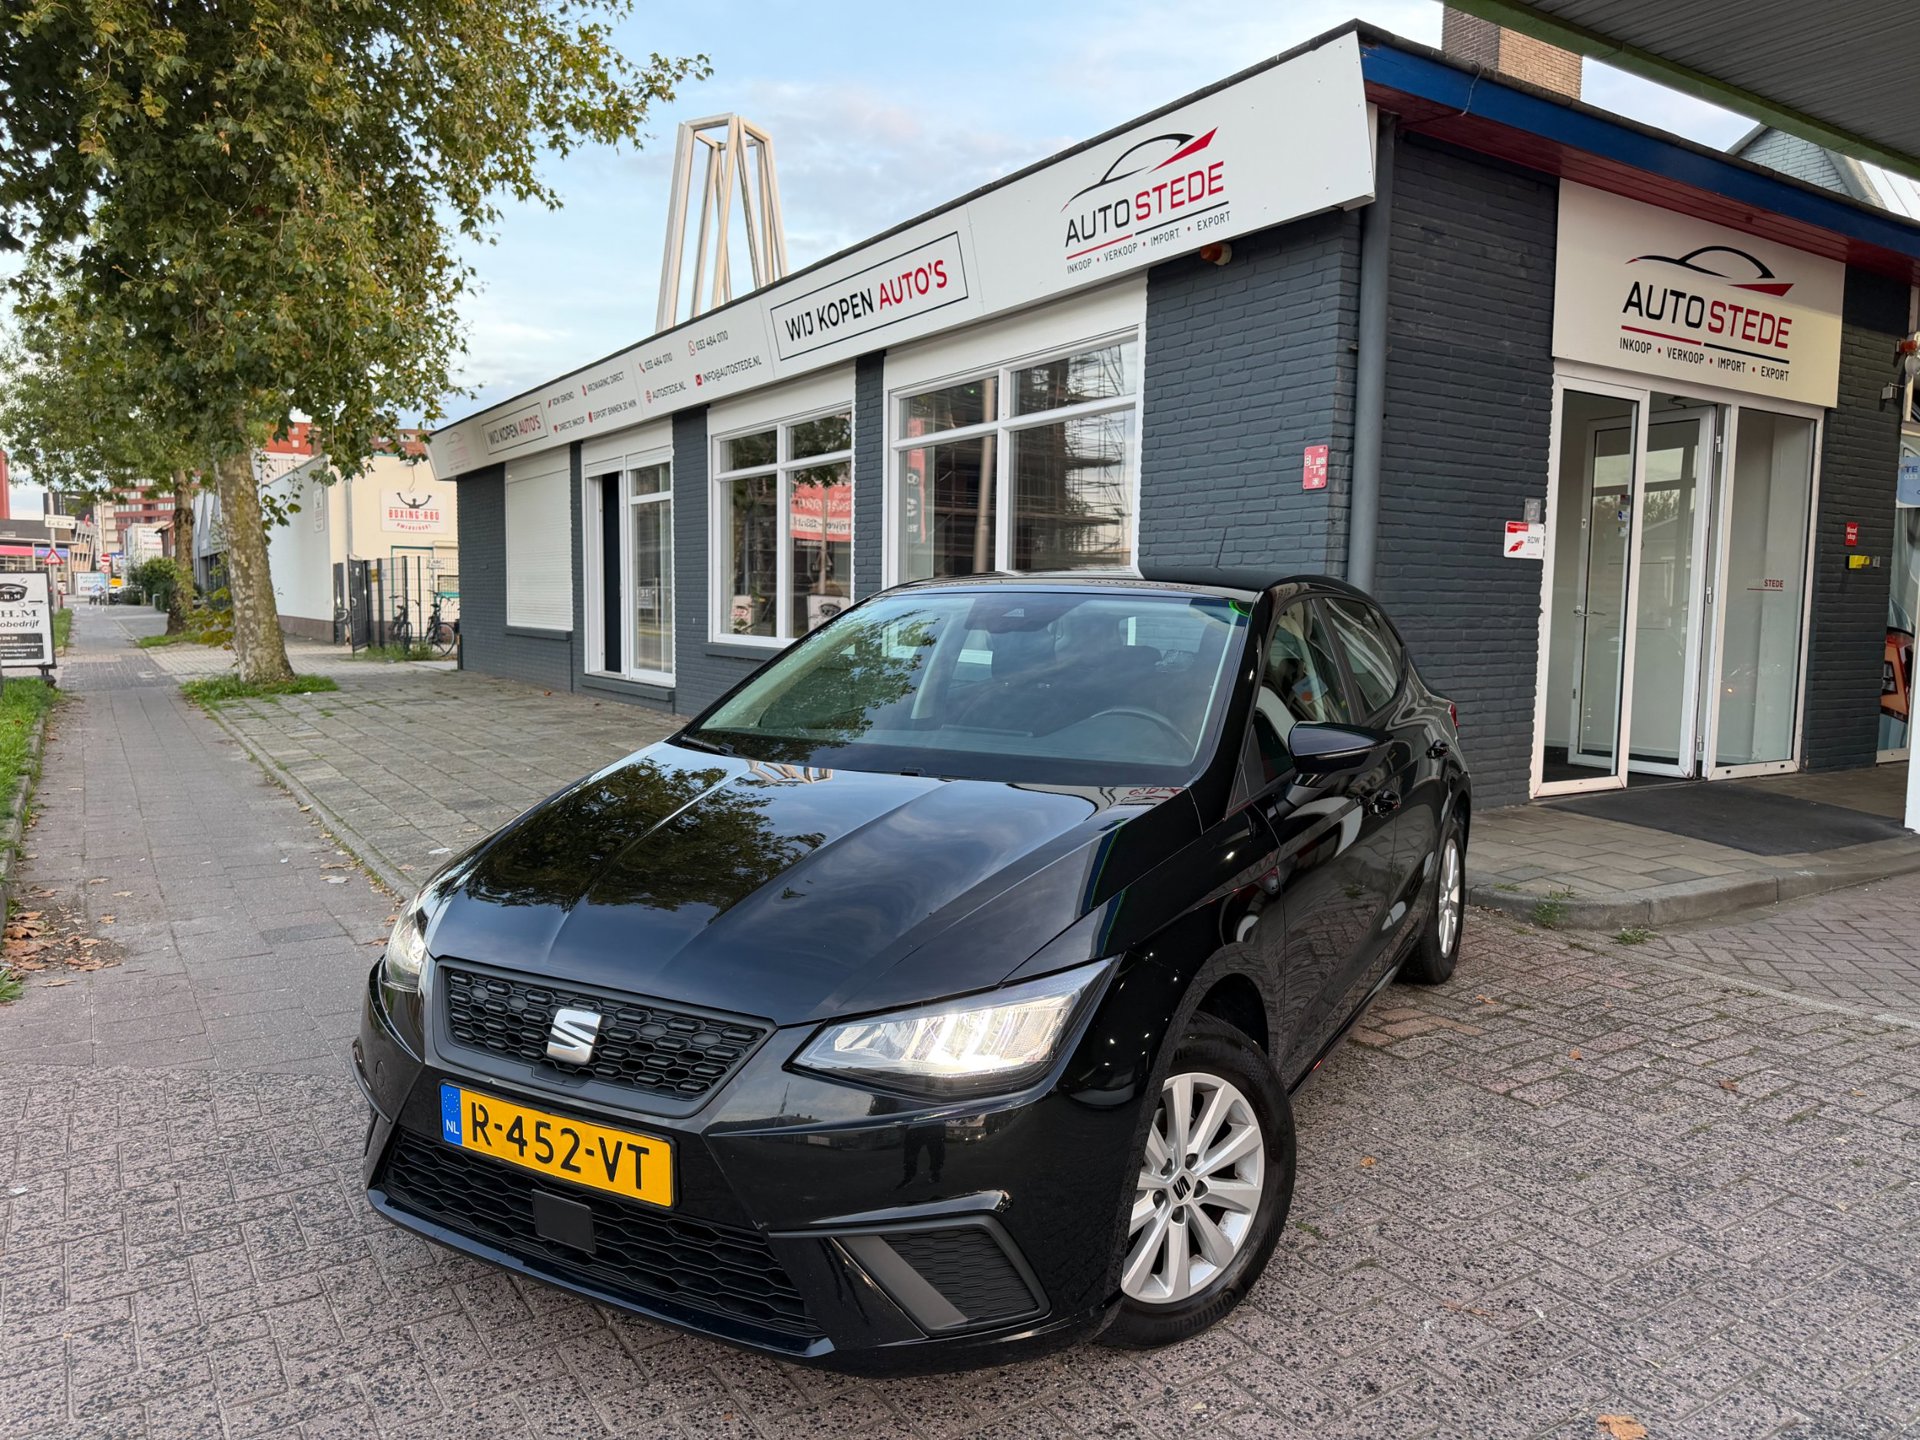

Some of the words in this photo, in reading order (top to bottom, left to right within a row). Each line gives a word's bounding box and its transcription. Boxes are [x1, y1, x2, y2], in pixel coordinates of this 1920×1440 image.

[1067, 258, 1092, 274] INKOOP
[1104, 242, 1138, 262] VERKOOP
[1150, 228, 1180, 246] IMPORT
[1197, 211, 1231, 231] EXPORT
[785, 311, 815, 341] WIJ
[816, 288, 874, 331] KOPEN
[879, 260, 948, 310] AUTO'S
[703, 355, 762, 383] INFO@AUTOSTEDE.NL
[1619, 337, 1652, 354] INKOOP
[1666, 347, 1704, 364] VERKOOP
[1717, 357, 1746, 373] IMPORT
[1761, 366, 1789, 382] EXPORT
[652, 381, 686, 399] AUTOSTEDE.NL
[499, 422, 520, 441] KOPEN
[518, 414, 541, 434] AUTO'S
[388, 509, 420, 520] BOXING
[446, 1120, 460, 1135] NL
[471, 1101, 650, 1190] R-452-VT
